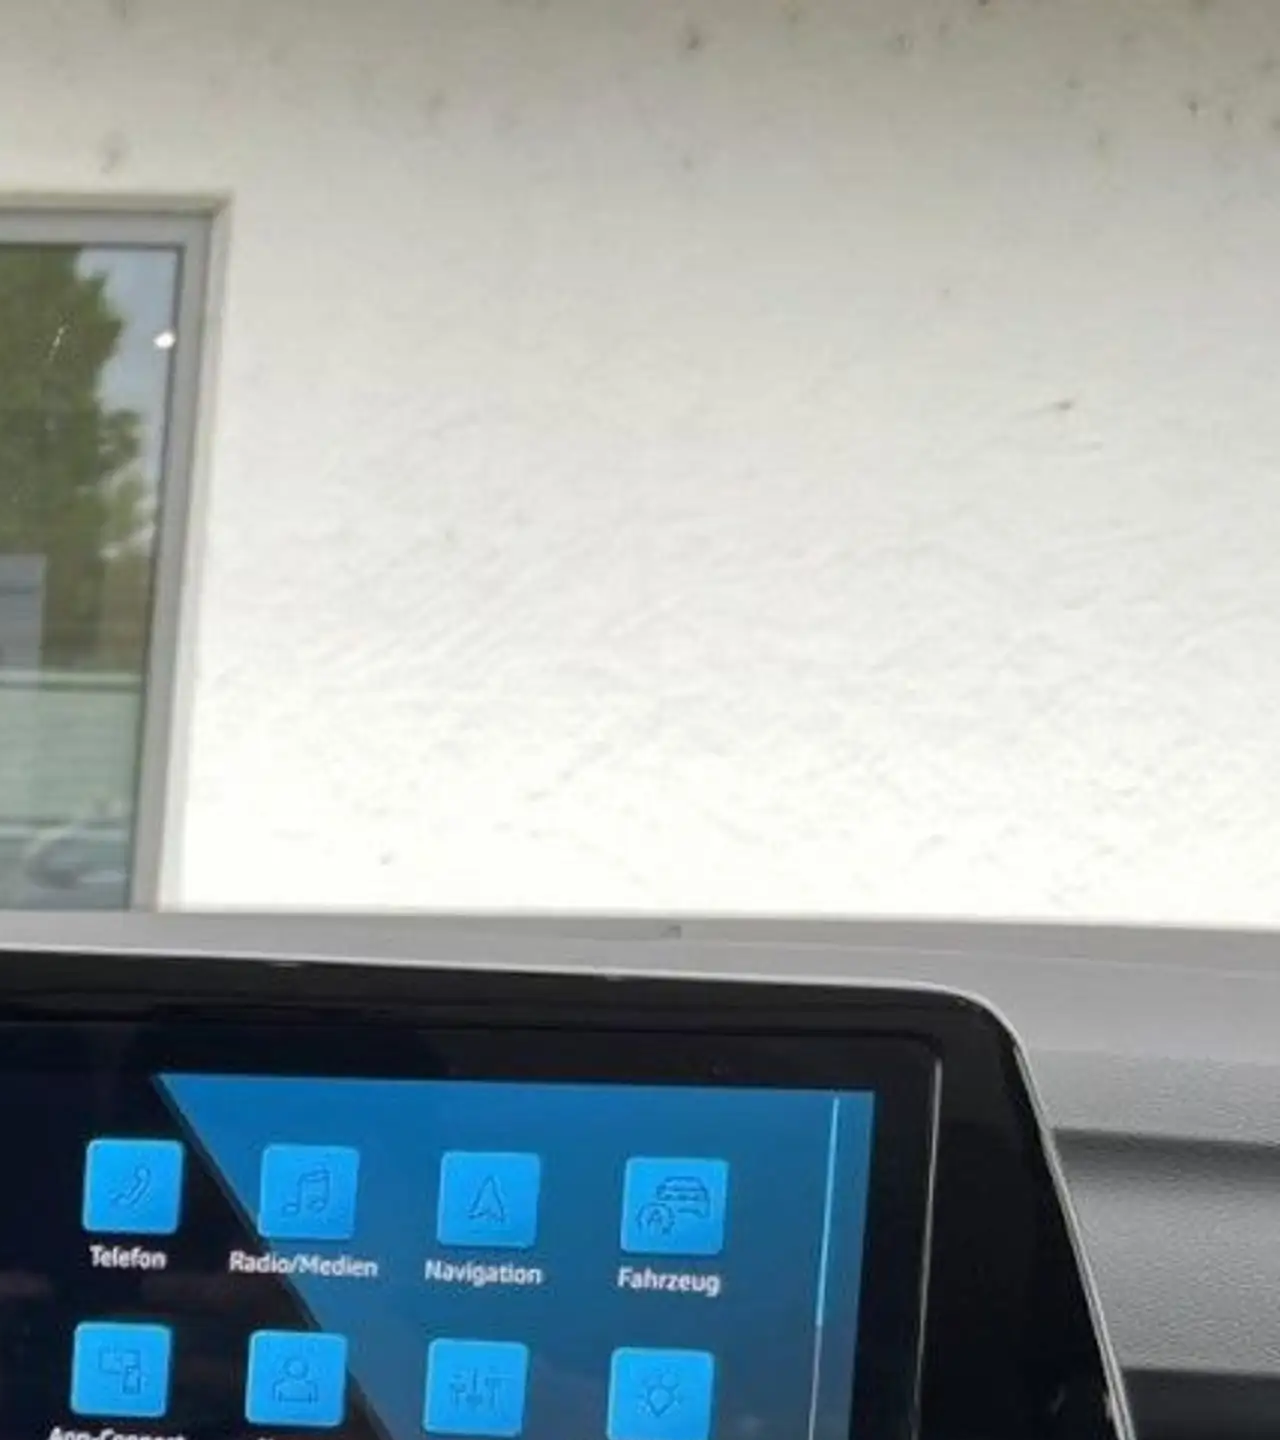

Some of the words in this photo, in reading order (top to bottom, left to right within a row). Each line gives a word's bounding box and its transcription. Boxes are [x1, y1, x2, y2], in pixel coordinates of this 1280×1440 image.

[89, 1245, 166, 1272] Telefon
[229, 1250, 379, 1280] Radio/Medien
[425, 1257, 543, 1287] Navigation
[617, 1267, 721, 1298] Fahrzeug
